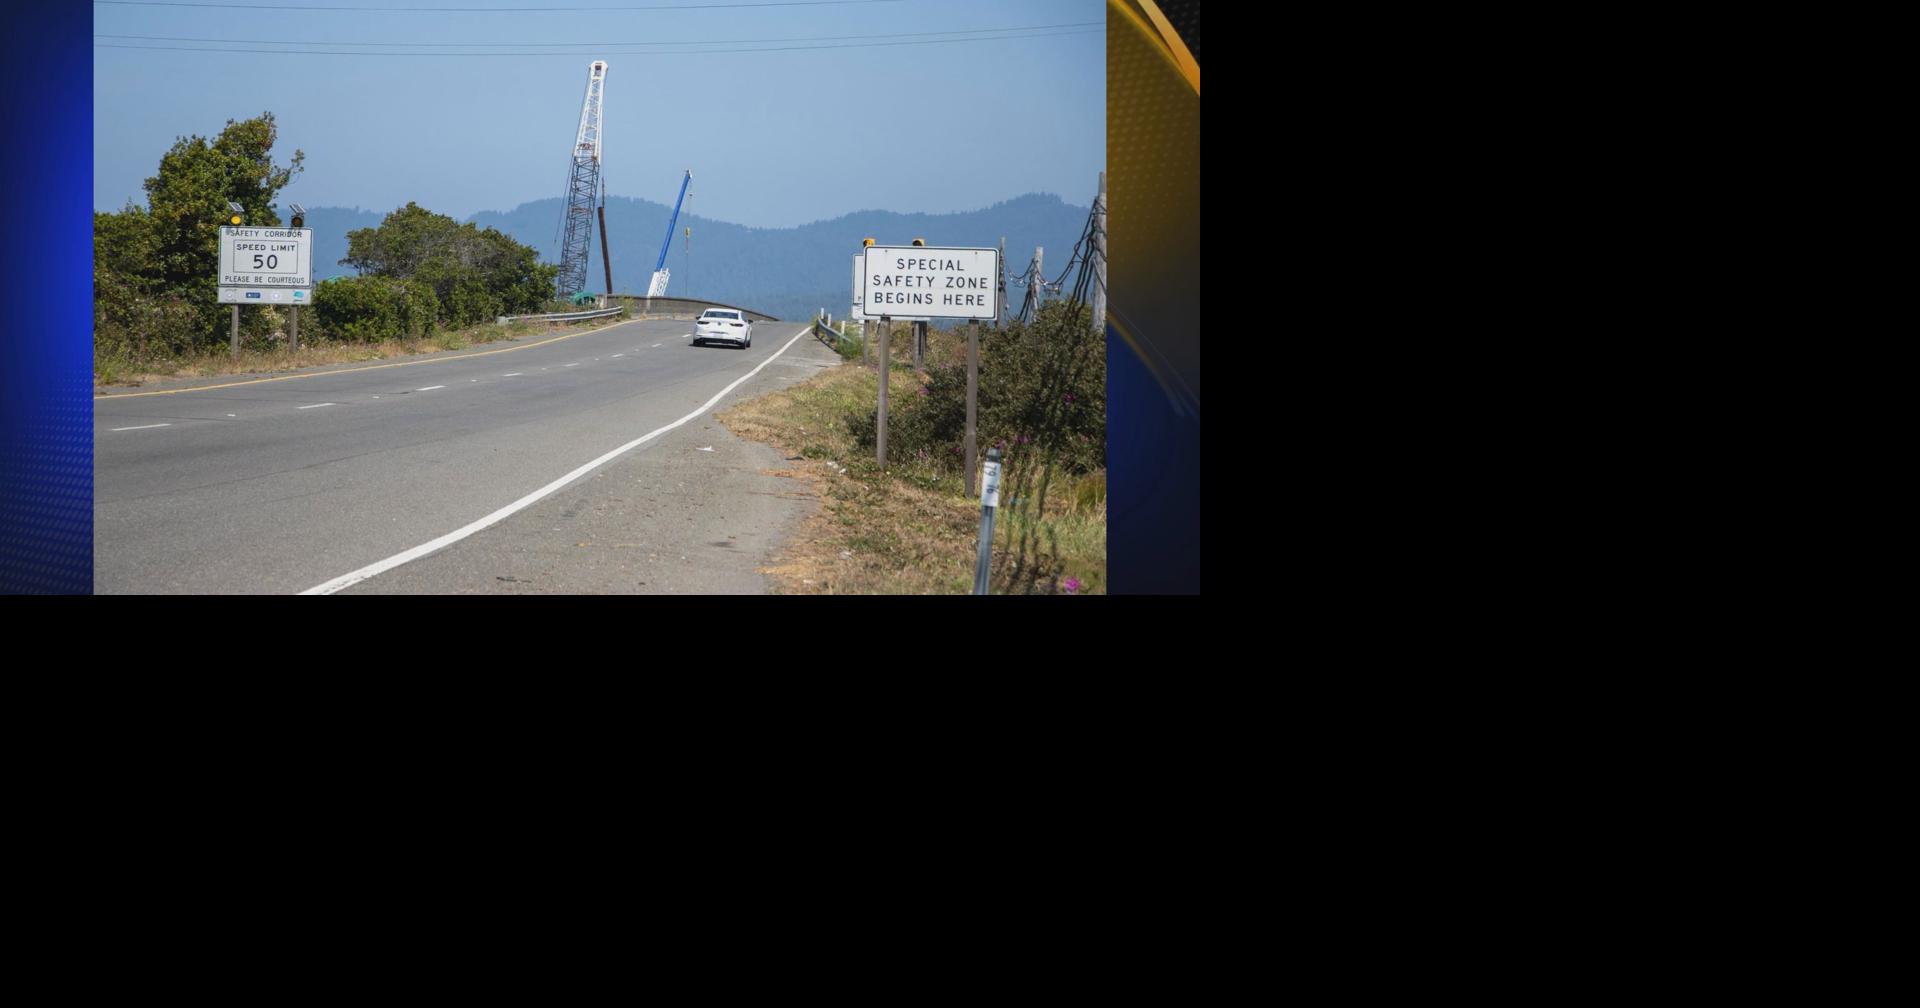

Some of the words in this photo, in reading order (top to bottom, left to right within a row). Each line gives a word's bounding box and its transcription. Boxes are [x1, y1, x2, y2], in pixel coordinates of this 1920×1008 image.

[253, 254, 278, 269] 50
[896, 258, 965, 271] SPECIAL
[873, 275, 935, 287] SAFETY
[946, 277, 988, 289] ZONE
[874, 292, 933, 305] BEGINS
[943, 294, 985, 306] HERE
